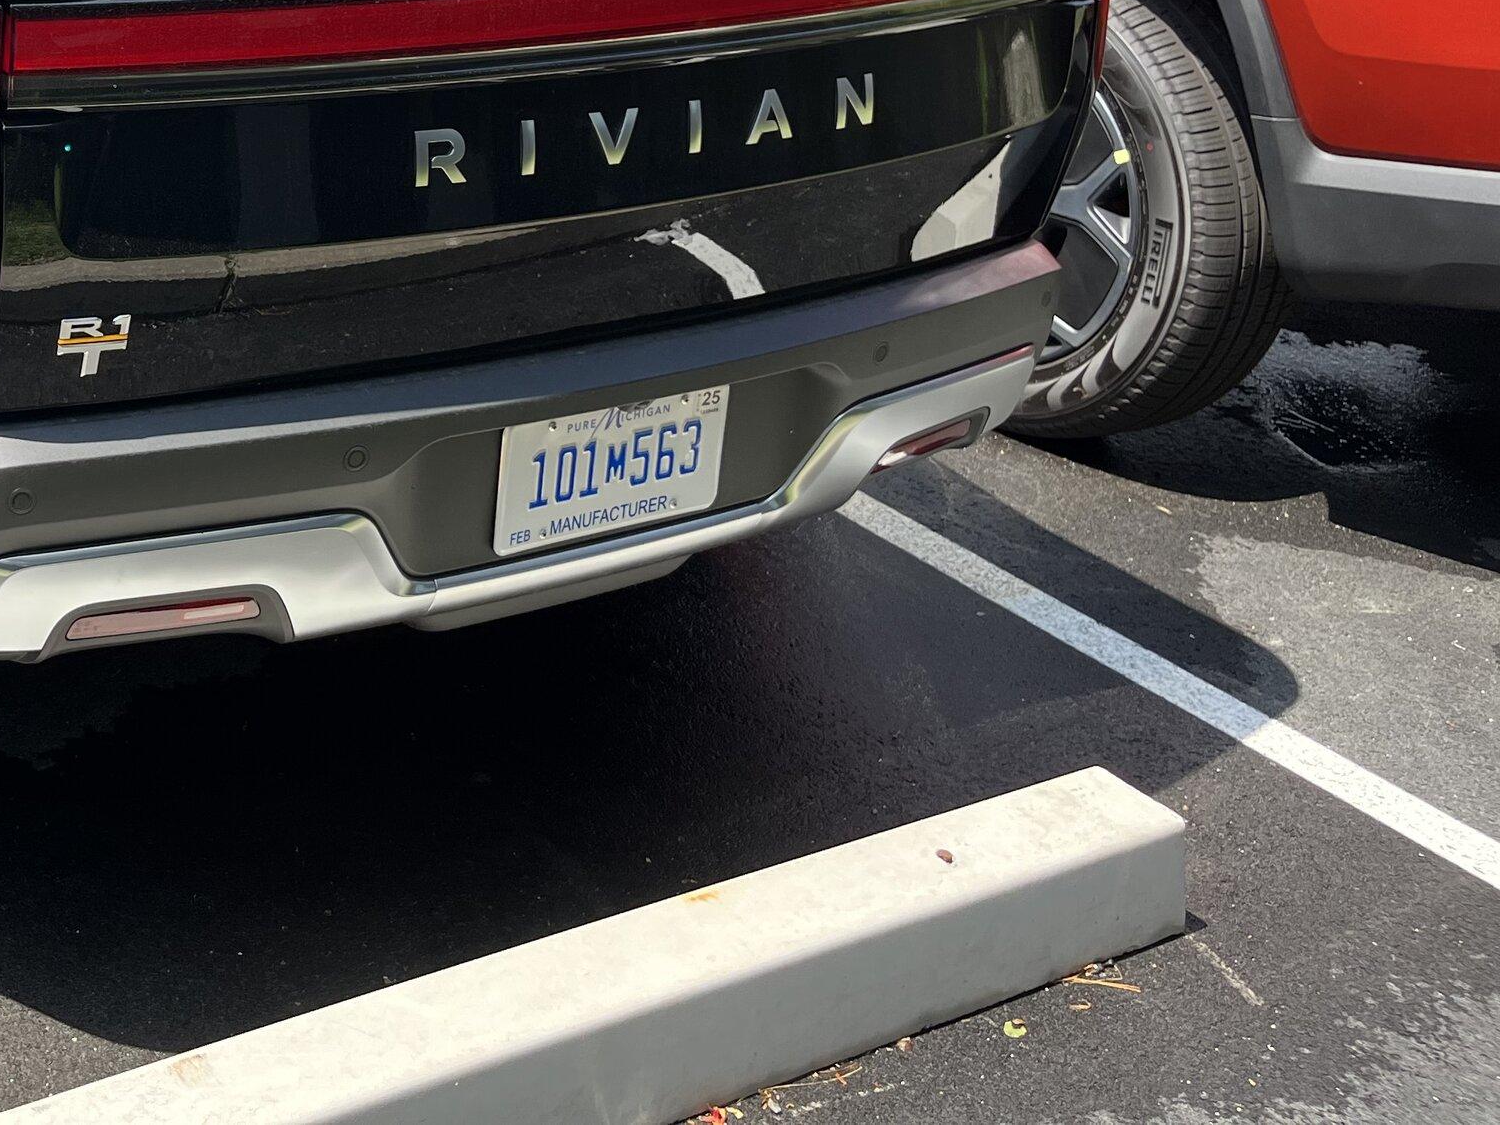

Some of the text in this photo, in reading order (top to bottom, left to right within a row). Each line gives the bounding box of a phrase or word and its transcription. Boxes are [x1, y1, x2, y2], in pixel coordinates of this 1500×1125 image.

[414, 72, 875, 188] RIVIAN
[701, 389, 721, 406] 25
[567, 418, 597, 433] PURE
[528, 418, 703, 510] 101M563
[509, 495, 668, 546] FEB MANUFACTURER
